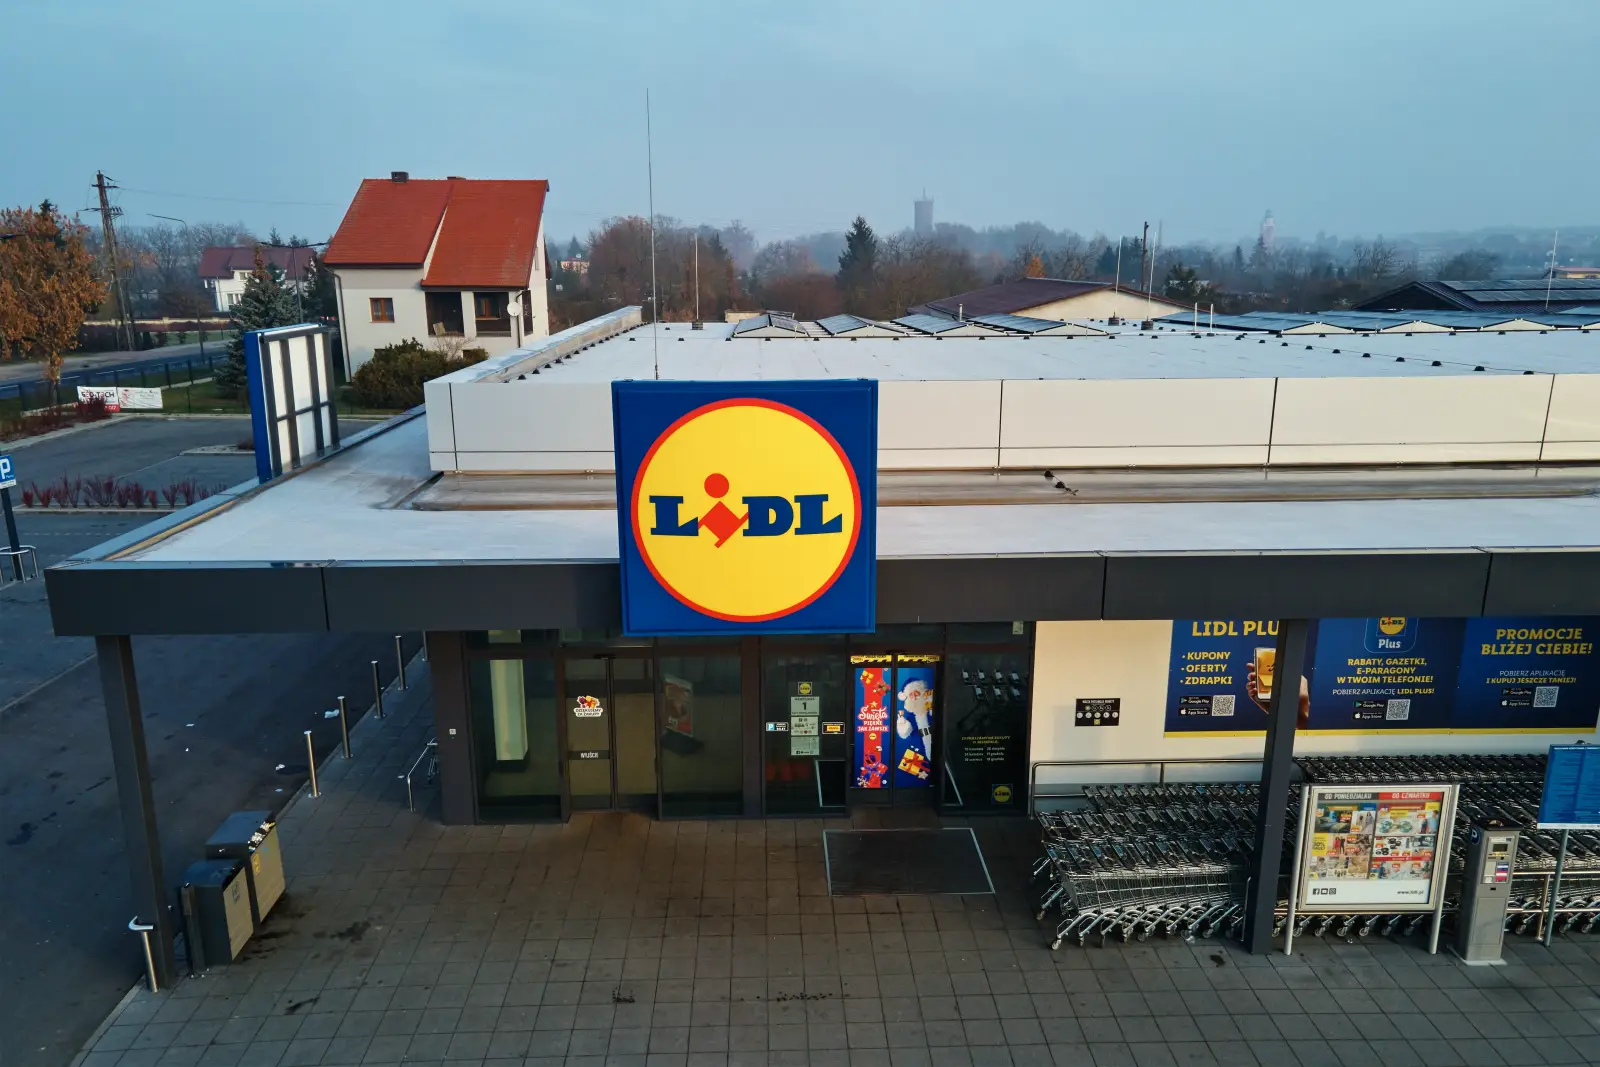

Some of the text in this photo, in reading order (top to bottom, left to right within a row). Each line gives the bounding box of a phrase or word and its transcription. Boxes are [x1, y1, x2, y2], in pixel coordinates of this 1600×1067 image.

[0, 458, 10, 479] P
[1192, 621, 1280, 636] LIDL PLU
[1496, 628, 1583, 640] PROMOCJE
[1378, 639, 1401, 649] Plus
[1481, 641, 1593, 655] BLIŻEJ CIEBIE!
[1187, 652, 1231, 660] KUPONY
[1347, 658, 1427, 666] RABATY, GAZETKI,
[1186, 664, 1227, 672] OFERTY
[1356, 667, 1416, 675] E-PARAGONY
[1184, 676, 1232, 685] ZDRAPKI
[1383, 675, 1433, 683] TELEFONIE!
